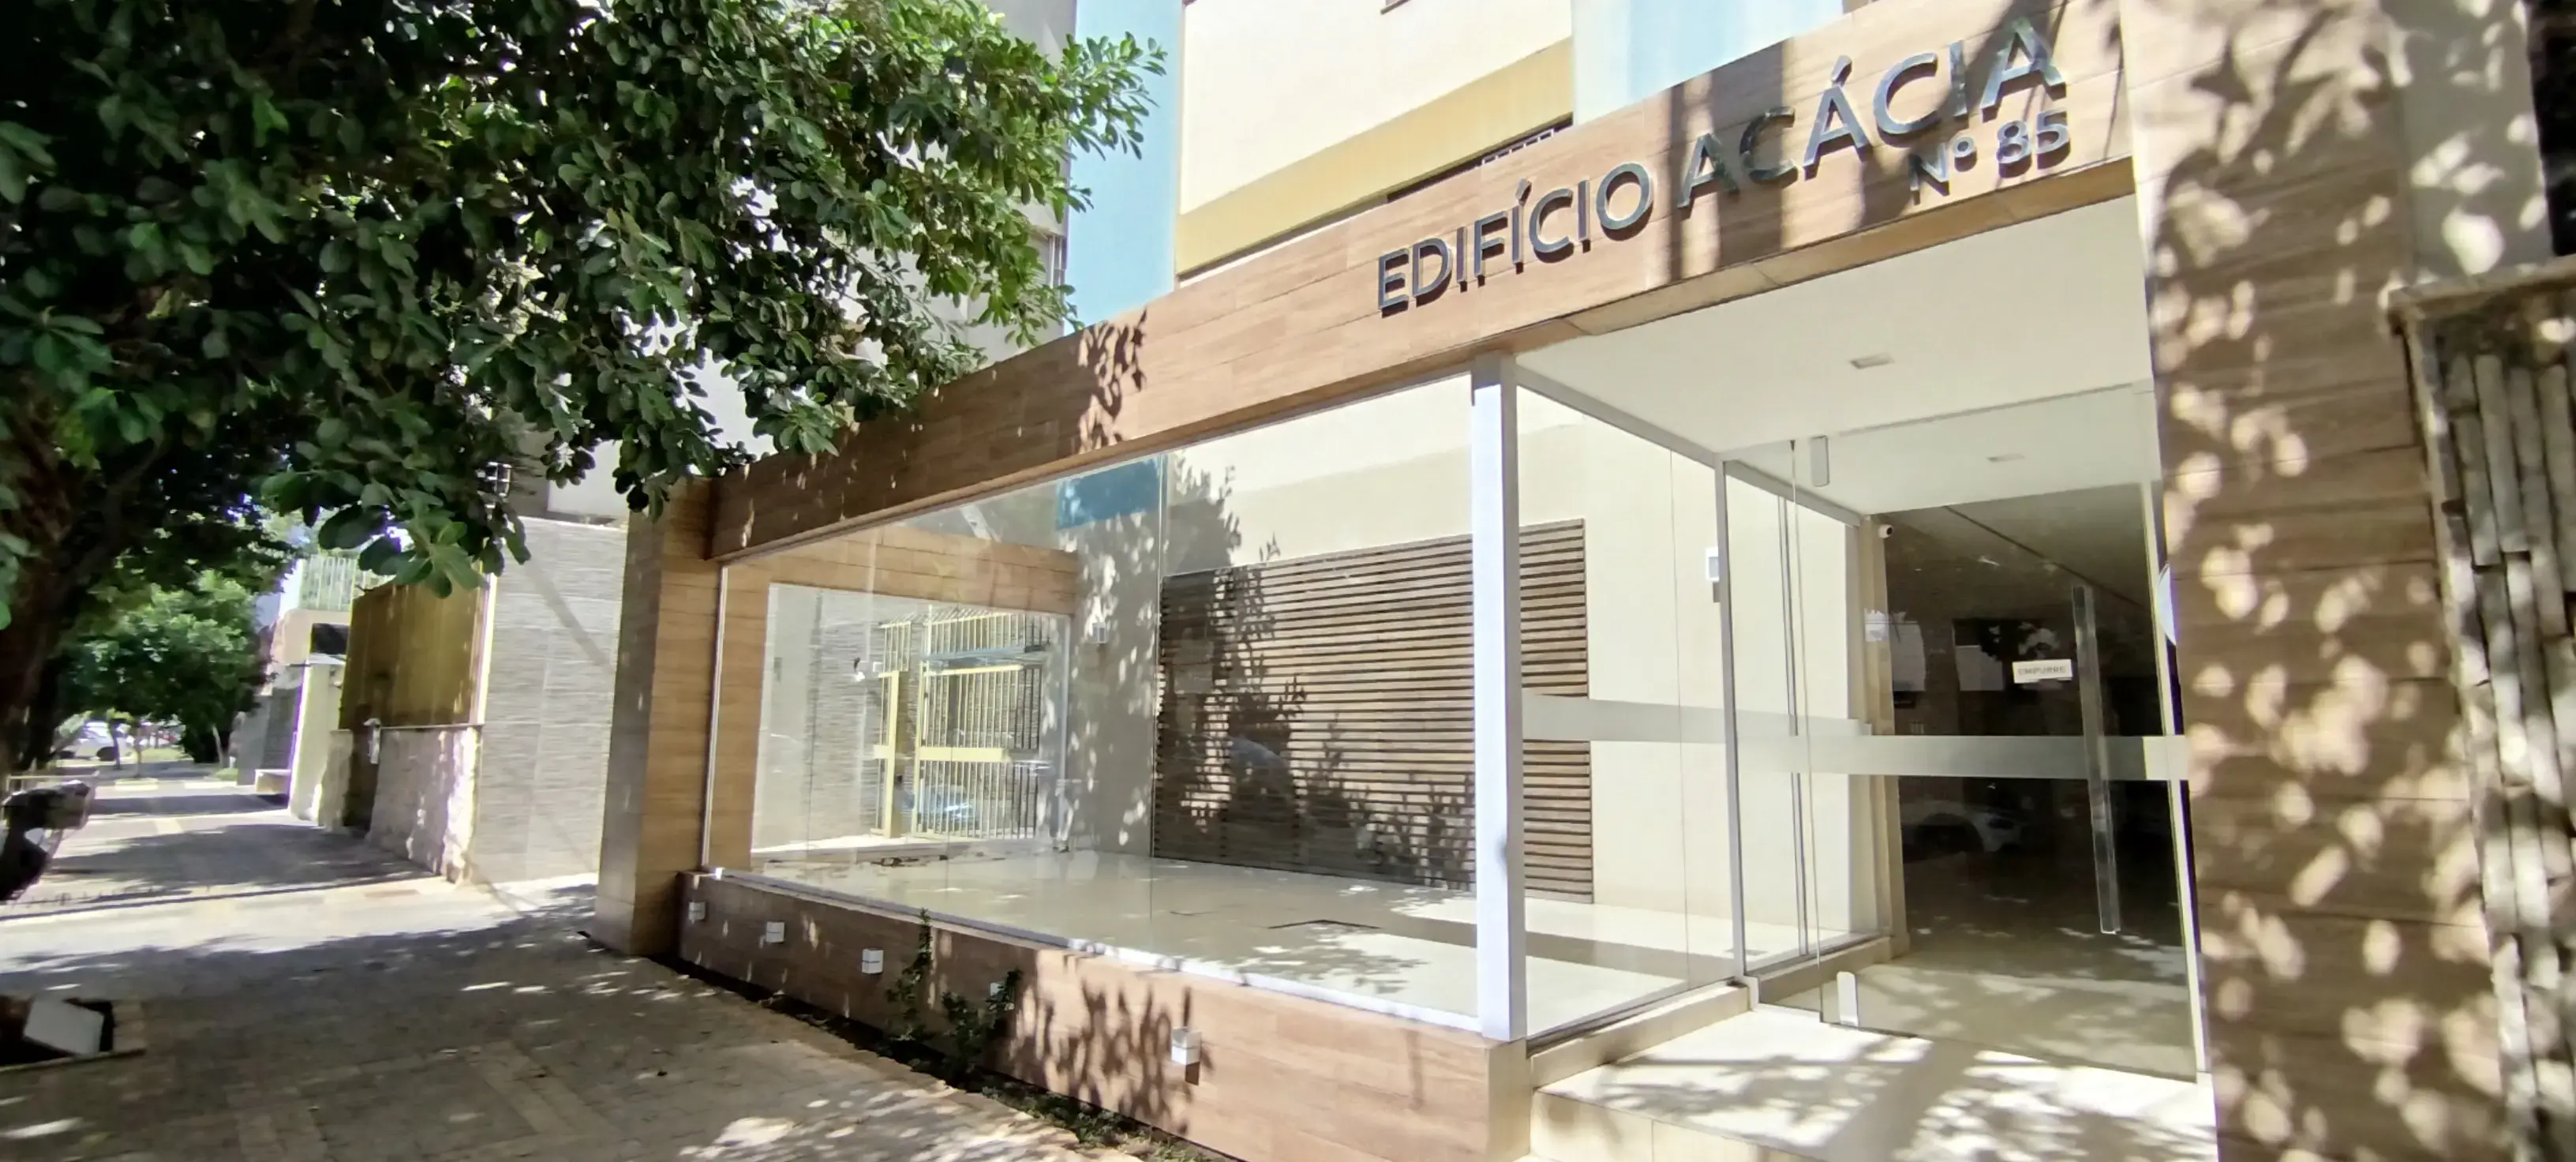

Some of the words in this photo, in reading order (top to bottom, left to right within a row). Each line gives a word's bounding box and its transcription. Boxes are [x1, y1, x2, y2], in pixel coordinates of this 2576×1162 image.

[1377, 162, 1653, 312] EDIFÍCIO
[1677, 16, 2065, 211] ACÁCIA
[1995, 107, 2071, 167] 85
